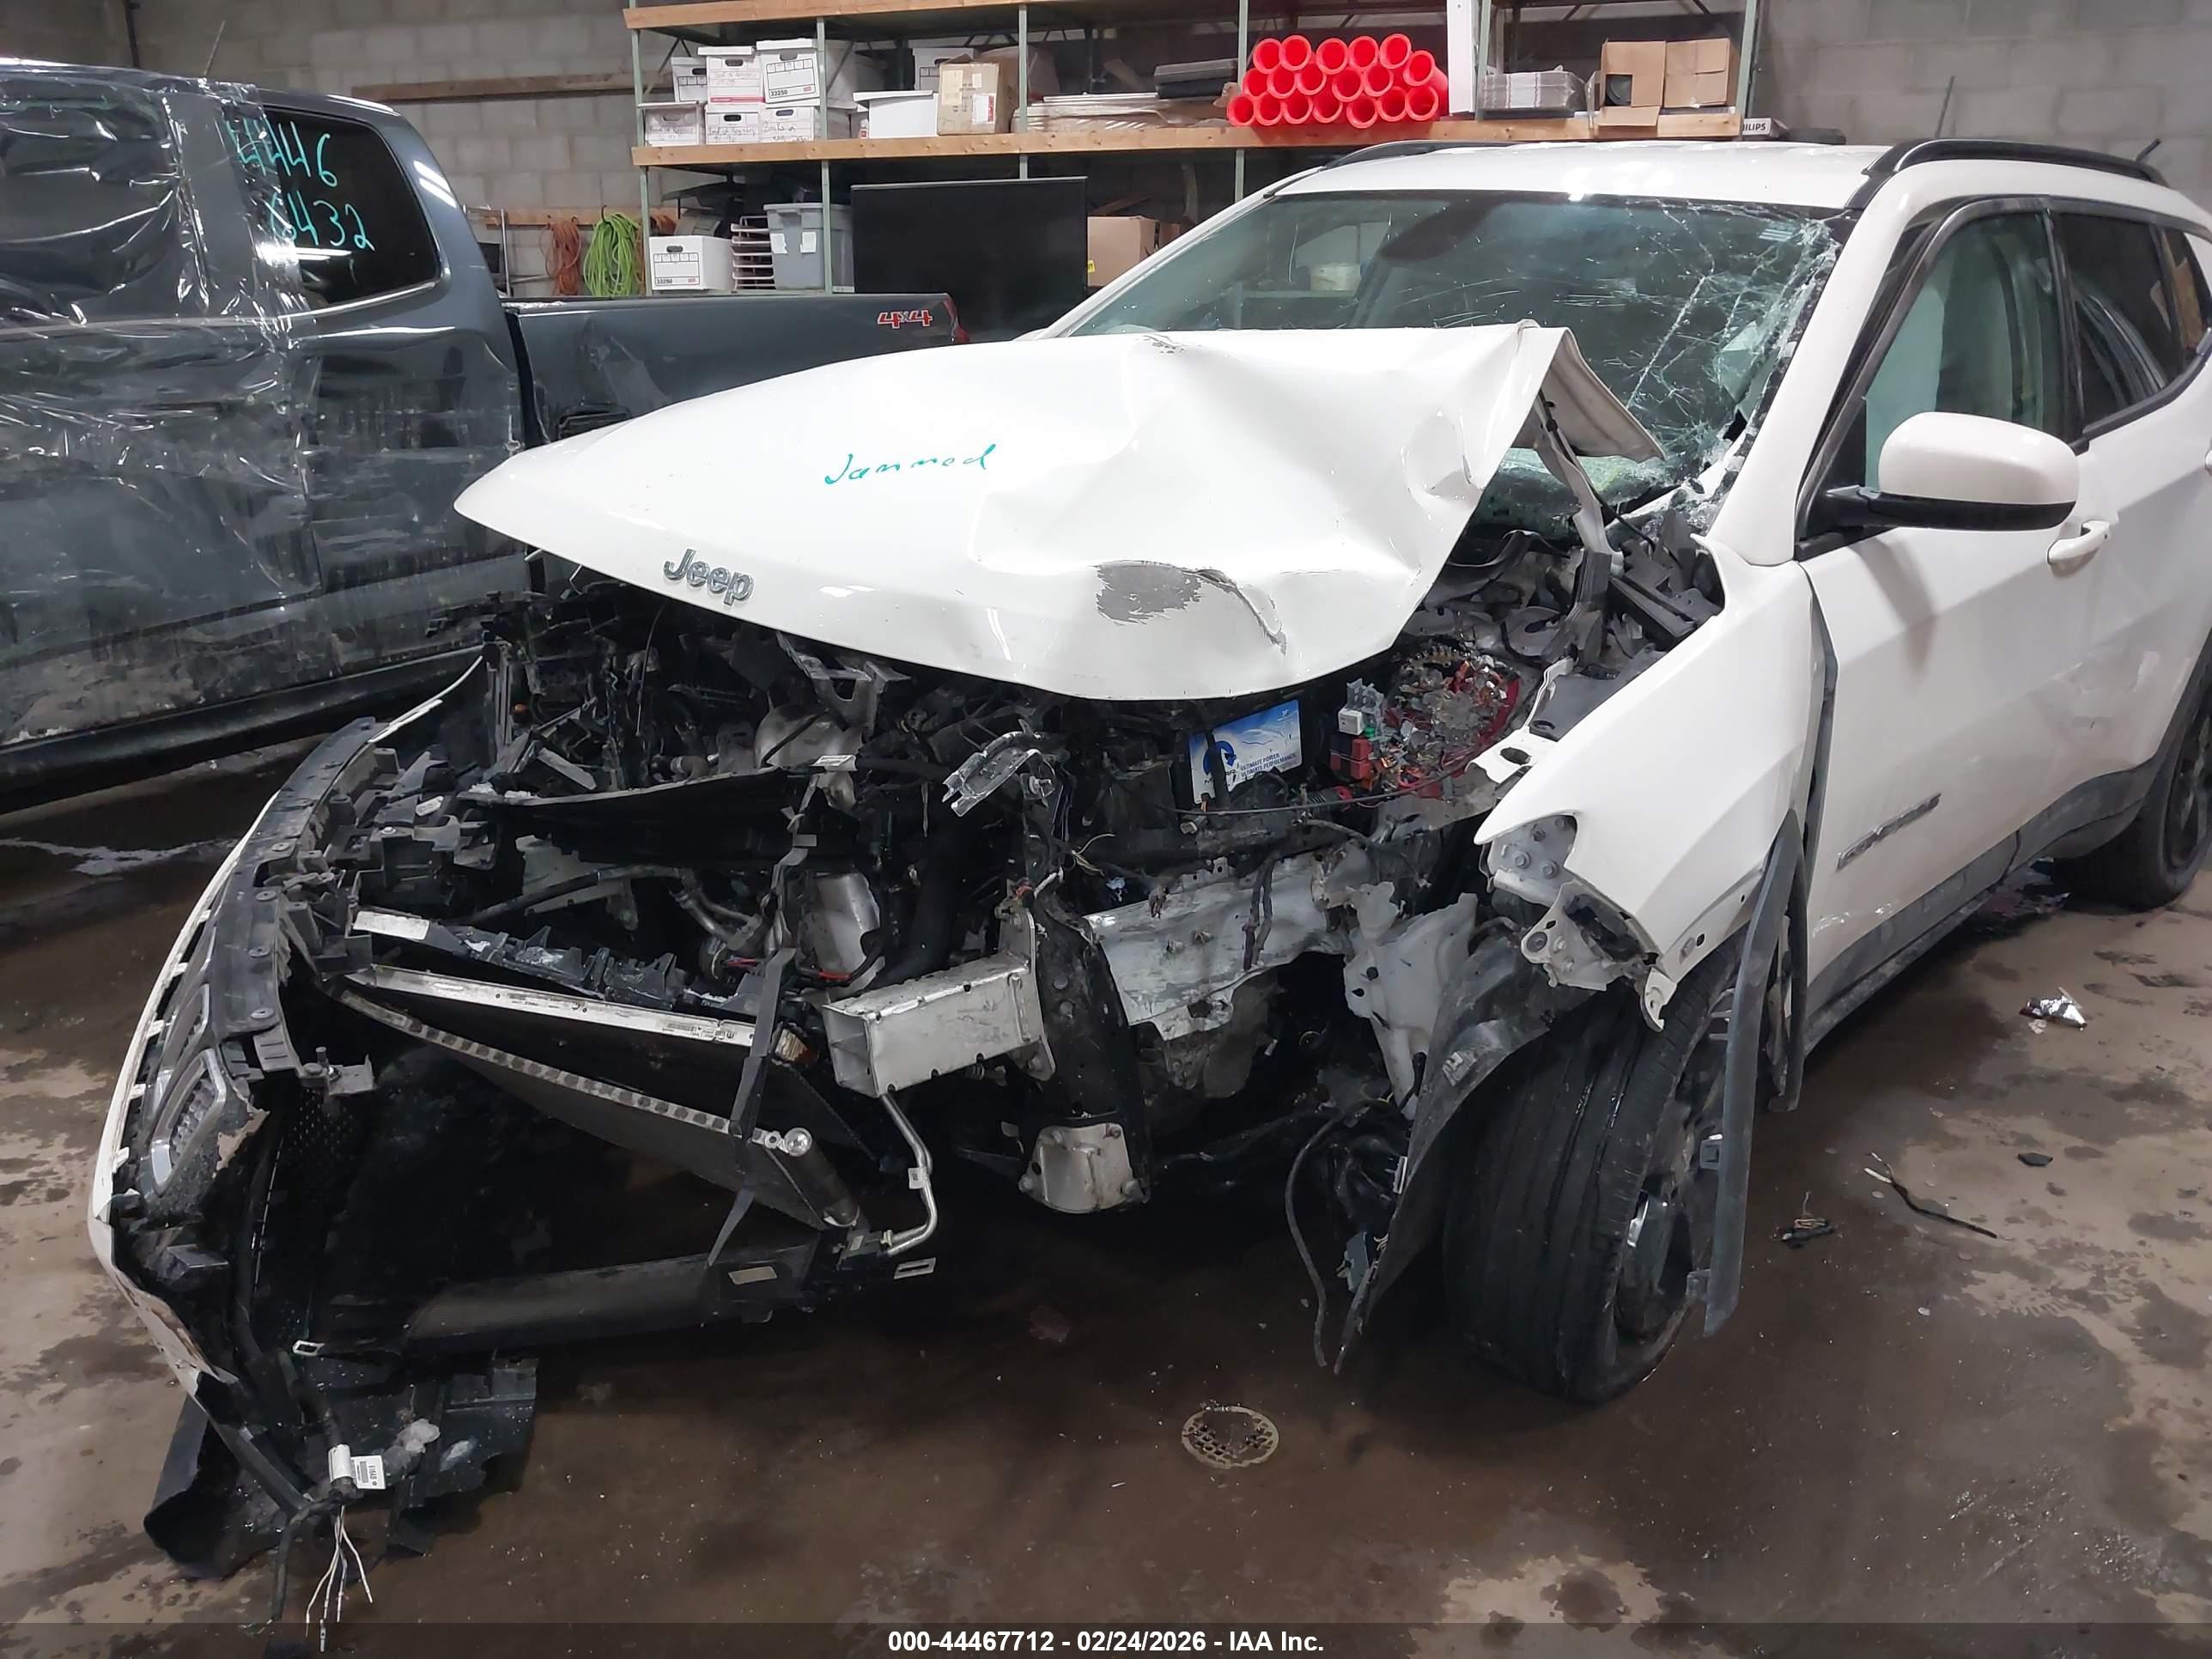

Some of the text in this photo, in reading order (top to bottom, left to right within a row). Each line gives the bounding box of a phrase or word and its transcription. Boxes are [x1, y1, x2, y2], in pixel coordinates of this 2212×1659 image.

[1743, 123, 1766, 131] ILIPS
[227, 118, 337, 187] 4446
[270, 190, 375, 251] 6432
[662, 548, 755, 606] Jeep
[1240, 759, 1262, 771] ULTIMATE
[1242, 765, 1263, 777] ULTIMATE
